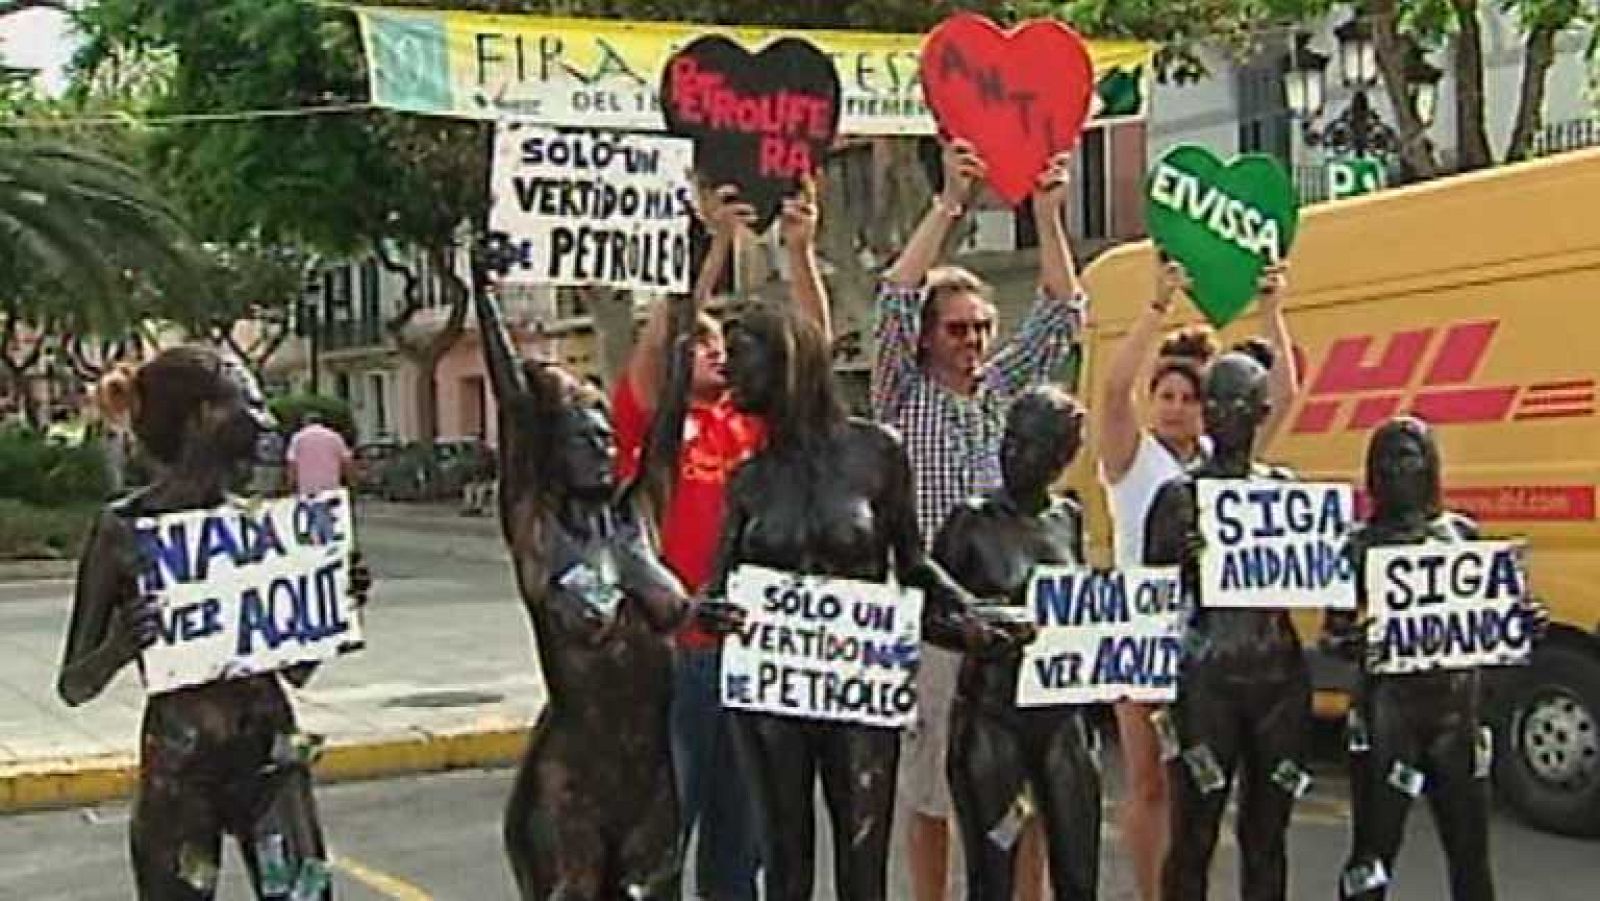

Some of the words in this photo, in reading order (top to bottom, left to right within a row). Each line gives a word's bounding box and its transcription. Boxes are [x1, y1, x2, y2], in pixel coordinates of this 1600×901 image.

[476, 33, 647, 85] FIRA
[571, 91, 622, 112] DEL
[623, 148, 659, 175] UN
[1151, 165, 1279, 263] EIVISSA
[1215, 488, 1346, 545] SIGA
[134, 510, 287, 593] NADA
[1036, 571, 1130, 627] NADA
[1386, 550, 1520, 612] SIGA
[853, 602, 895, 632] UN
[1034, 652, 1082, 688] VER
